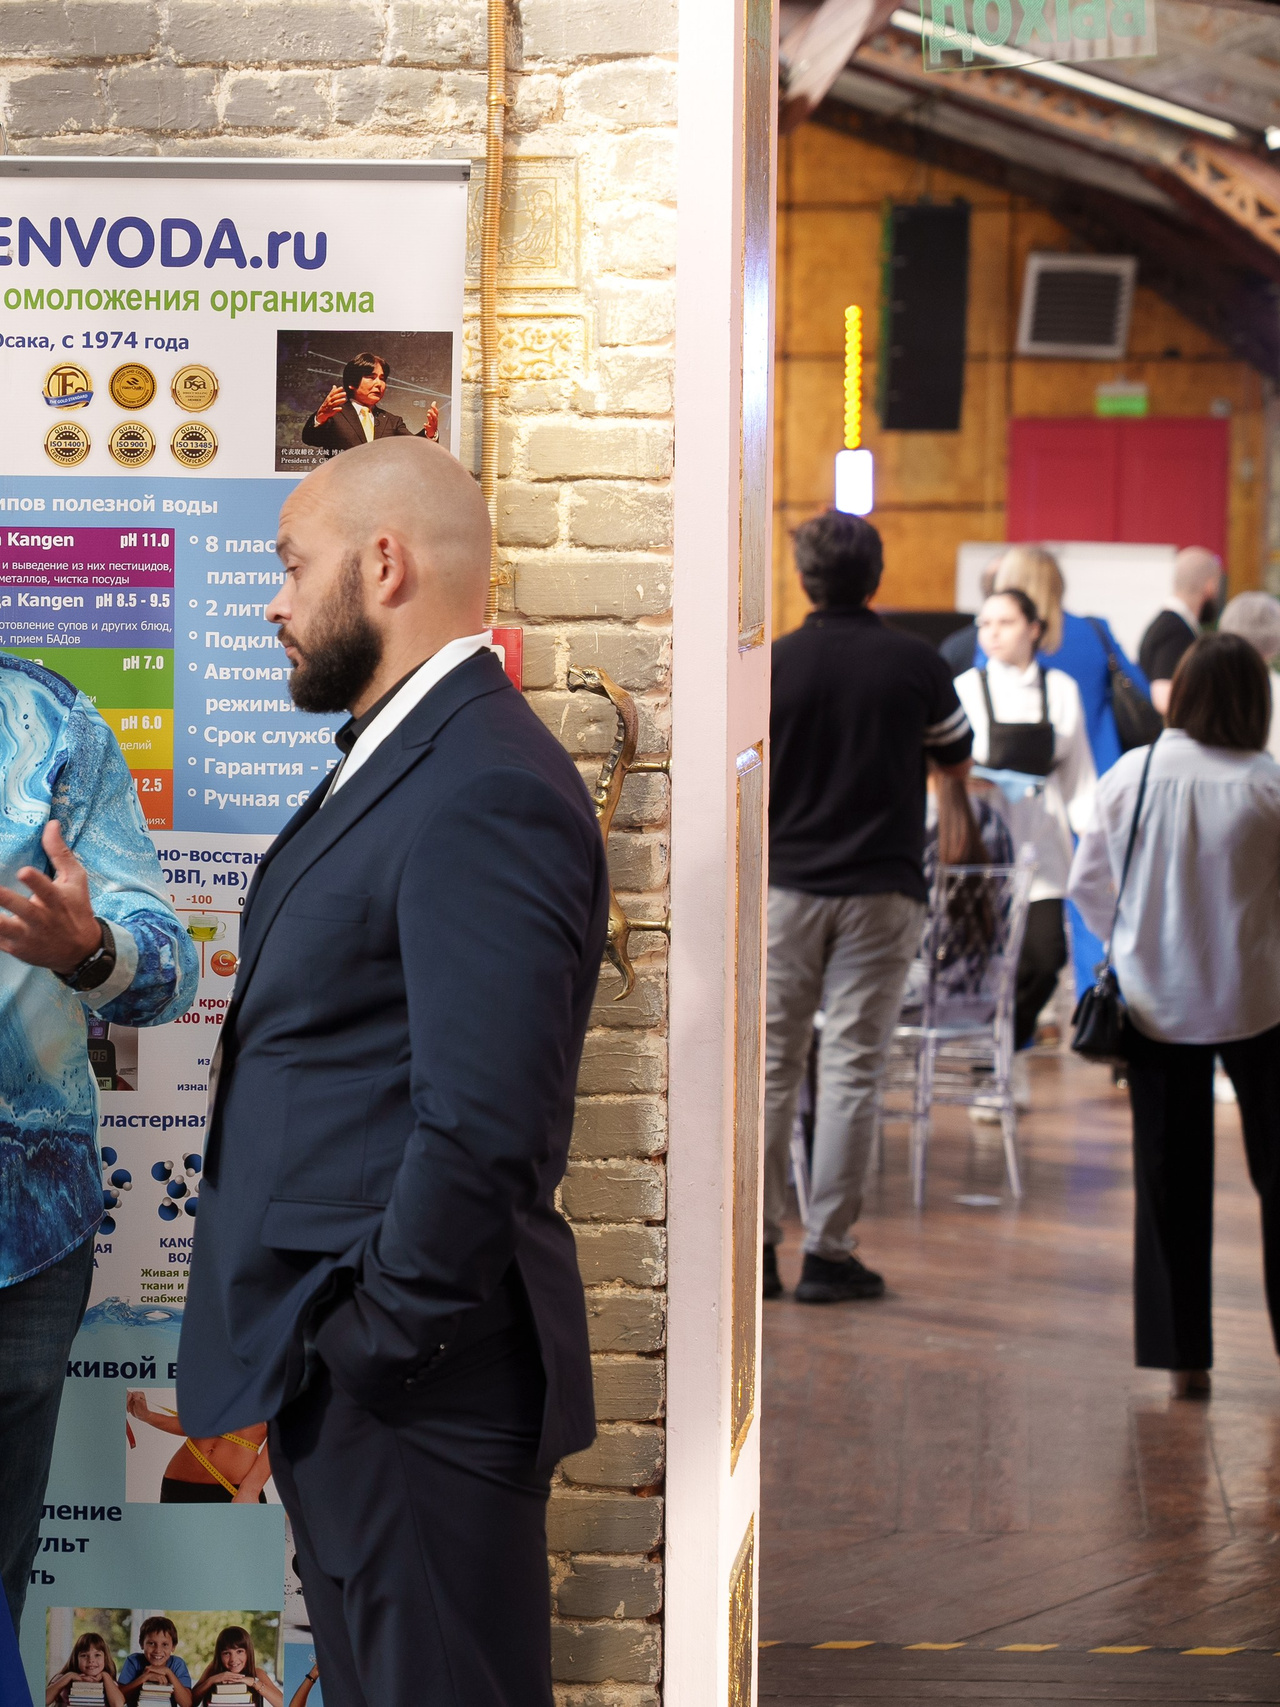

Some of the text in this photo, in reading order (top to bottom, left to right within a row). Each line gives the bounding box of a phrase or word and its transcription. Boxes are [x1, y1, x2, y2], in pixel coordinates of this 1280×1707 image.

[3, 287, 200, 312] омоложения
[210, 289, 375, 319] организма
[81, 331, 138, 349] 1974
[144, 335, 190, 352] года
[54, 426, 82, 434] QUALITY
[118, 426, 147, 434] QUALITY
[180, 426, 209, 434] QUALITY
[190, 441, 212, 449] 13485
[50, 448, 85, 463] CERTIFICATION
[114, 448, 149, 463] CERTIFICATION
[176, 448, 212, 464] CERTIFICATION
[53, 494, 156, 512] полезной
[162, 498, 219, 515] воды
[8, 532, 75, 549] Kangen
[120, 534, 170, 549] pH 11.0
[205, 536, 277, 553] 8 плас
[2, 562, 9, 570] и
[11, 562, 69, 573] выведение
[72, 562, 84, 570] из
[87, 562, 106, 571] них
[108, 562, 173, 574] пестицидов,
[53, 576, 89, 584] чистка
[92, 576, 130, 586] посуды
[17, 592, 84, 610] Kangen
[95, 594, 171, 609] pH 8.5 9.5
[205, 600, 218, 616] 2
[57, 622, 88, 632] супов
[91, 622, 98, 630] и
[101, 622, 138, 633] других
[140, 622, 173, 633] блюд,
[10, 636, 43, 645] прием
[46, 634, 81, 645] БАДов
[123, 655, 164, 671] pH 7.0
[206, 699, 296, 715] режимы
[121, 715, 162, 731] pH 6.0
[204, 726, 256, 746] Срок
[204, 757, 303, 776] Гарантия
[142, 778, 163, 792] 2.5
[204, 789, 280, 809] Ручная
[213, 871, 248, 891] мВ)
[186, 895, 212, 905] -100
[238, 897, 245, 906] 0
[100, 1114, 206, 1131] ластерная
[141, 1269, 179, 1277] Живая
